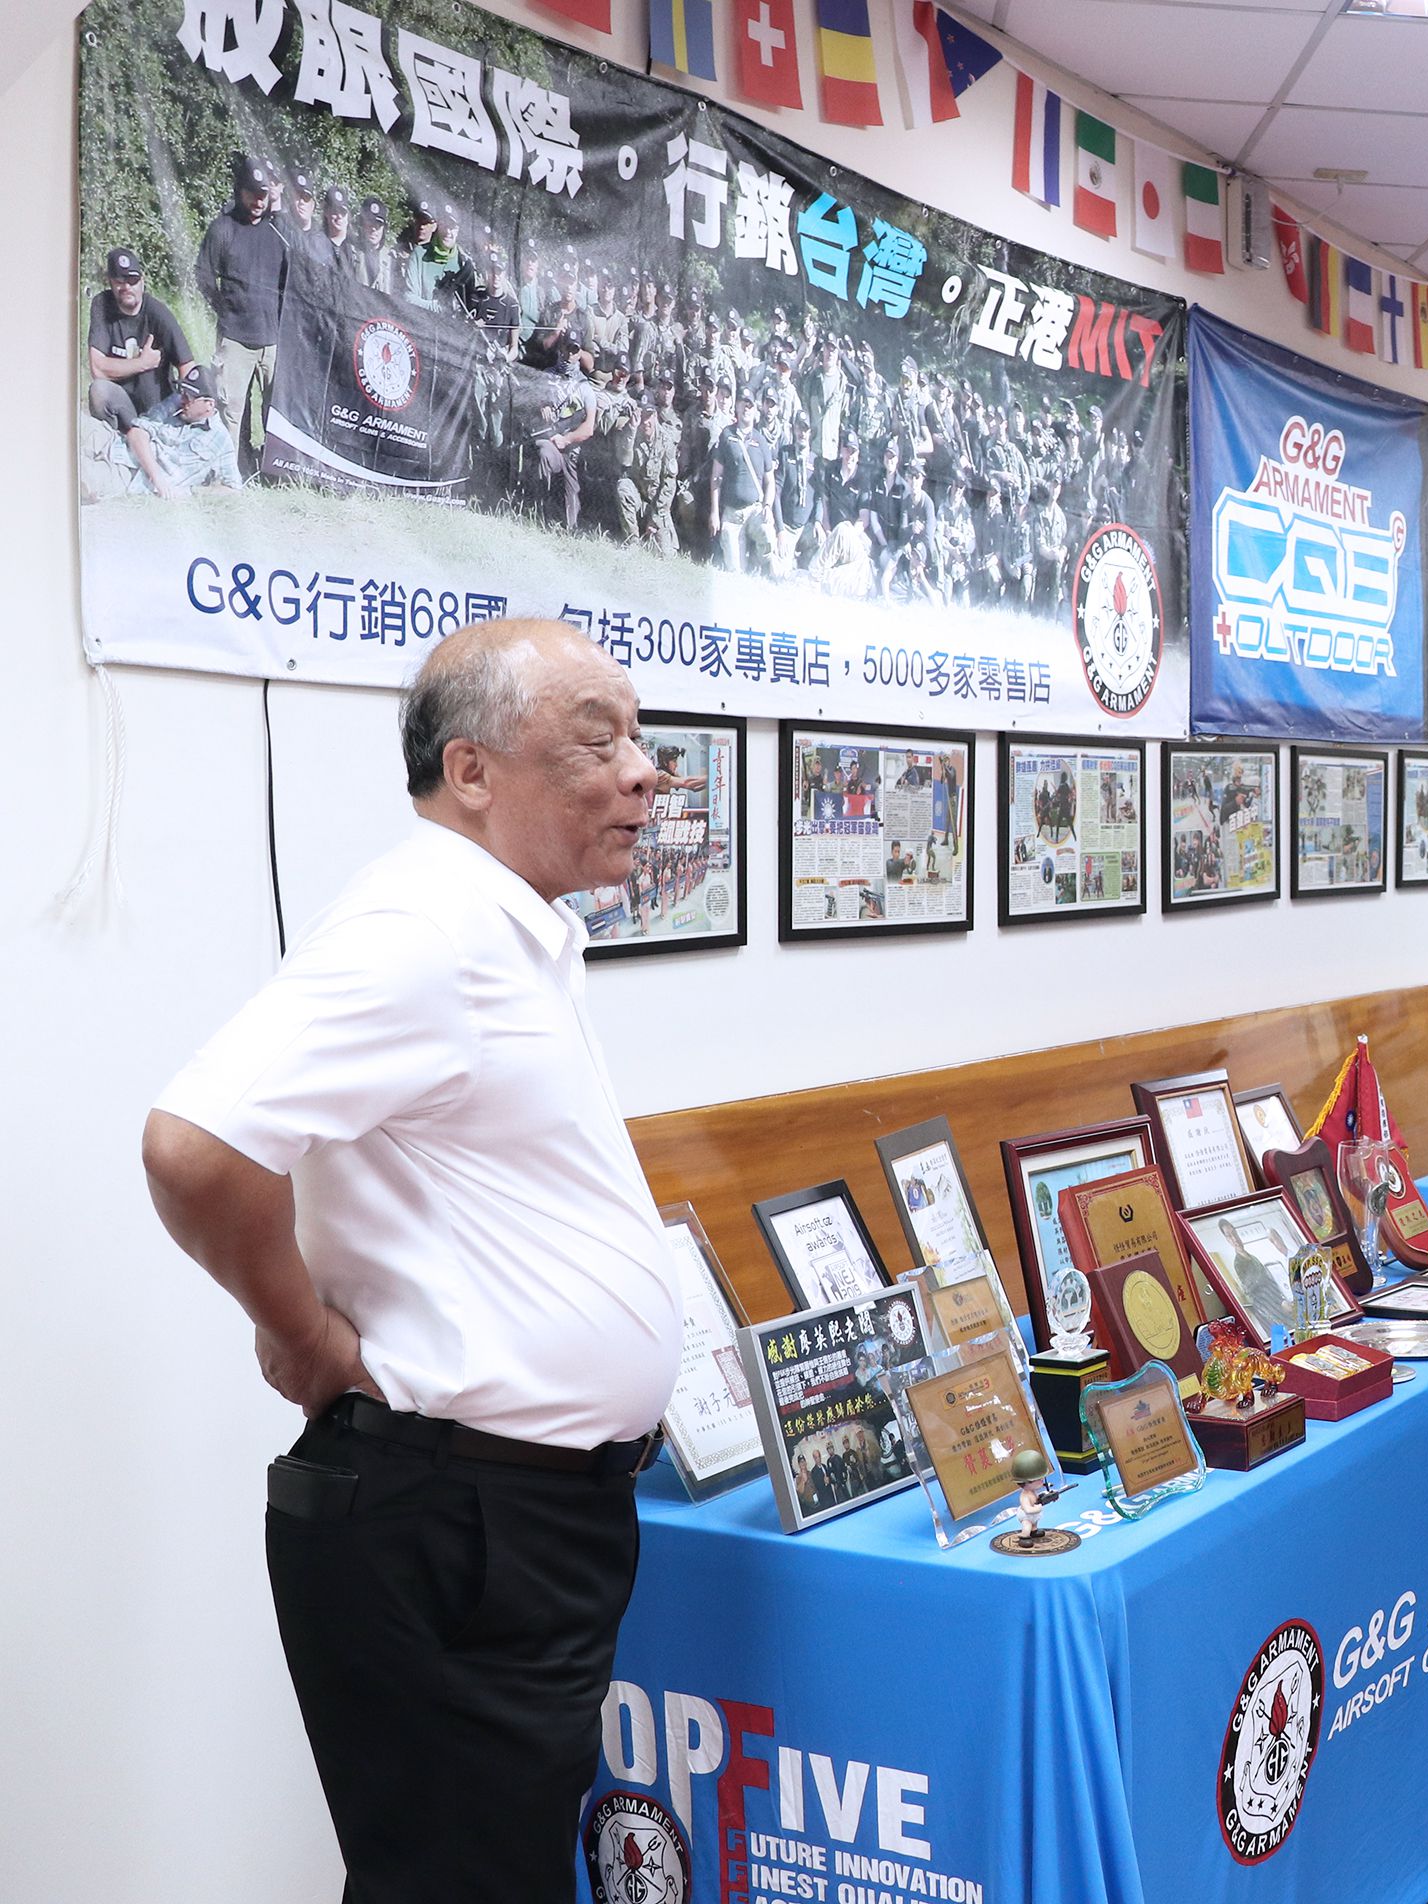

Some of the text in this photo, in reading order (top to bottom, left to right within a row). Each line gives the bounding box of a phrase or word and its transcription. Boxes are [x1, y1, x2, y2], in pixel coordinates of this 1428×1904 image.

[331, 405, 428, 441] G&G ARMAMENT
[1283, 421, 1344, 476] G&G
[1253, 463, 1370, 525] ARMAMENT
[1080, 531, 1157, 592] G&G ARMAMENT
[1083, 645, 1158, 712] G&G ARMAMENT
[806, 1233, 838, 1252] awards
[1332, 1590, 1417, 1689] G&G
[1231, 1627, 1320, 1733] G&G ARMAMENT
[1327, 1655, 1415, 1741] AIRSOFT
[599, 1680, 724, 1850] OP
[593, 1796, 684, 1853] G&G ARMAMENT
[1225, 1741, 1313, 1857] G&G ARMAMENT
[834, 1849, 983, 1903] INNOVATION
